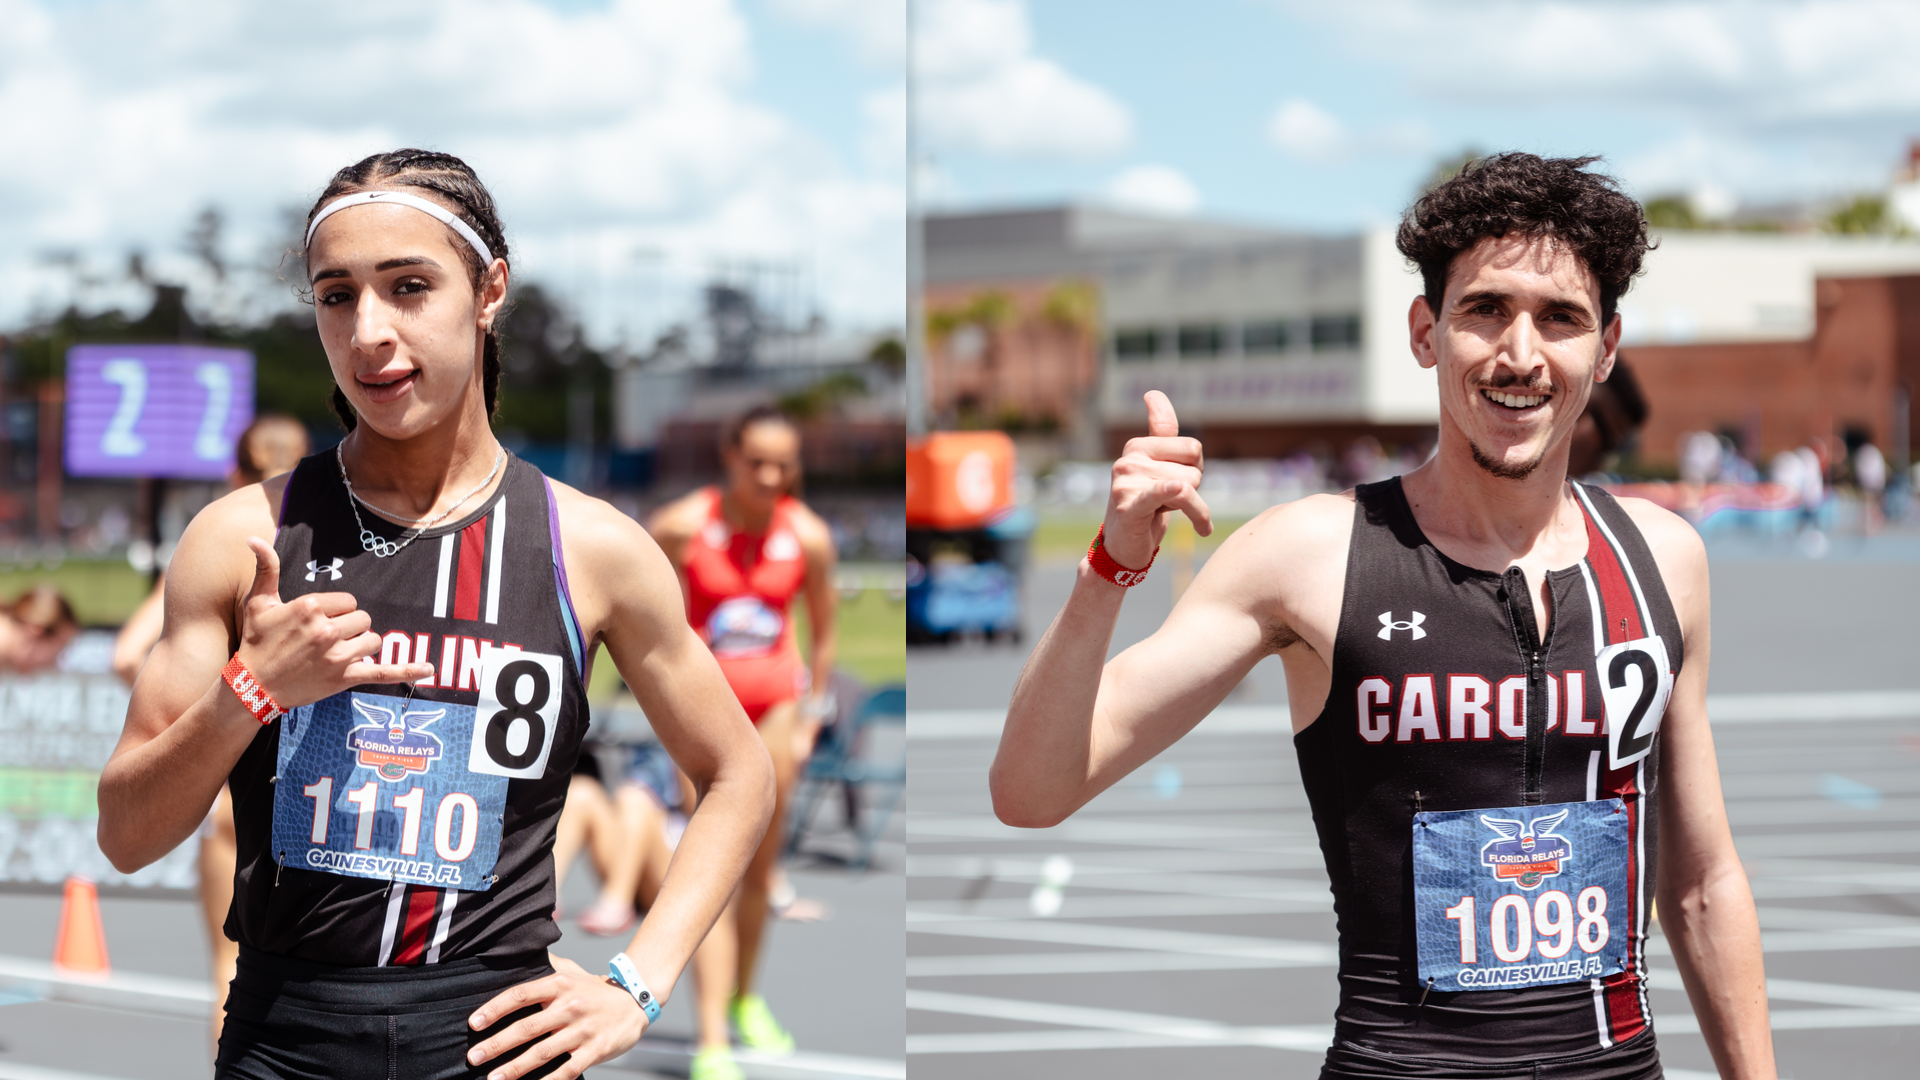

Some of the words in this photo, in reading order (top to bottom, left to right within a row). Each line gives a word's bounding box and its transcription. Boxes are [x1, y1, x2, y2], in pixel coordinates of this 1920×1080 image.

[485, 659, 551, 770] 8
[1608, 649, 1658, 760] 2
[354, 738, 396, 754] FLORIDA
[397, 745, 435, 756] RELAYS
[303, 776, 479, 862] 1110
[307, 849, 435, 884] GAINESVILLE,
[436, 865, 461, 884] FL
[1488, 853, 1530, 863] FLORIDA
[1531, 848, 1565, 862] RELAYS
[1446, 885, 1610, 964] 1098
[1458, 960, 1583, 986] GAINESVILLE,
[1584, 956, 1602, 976] FL
